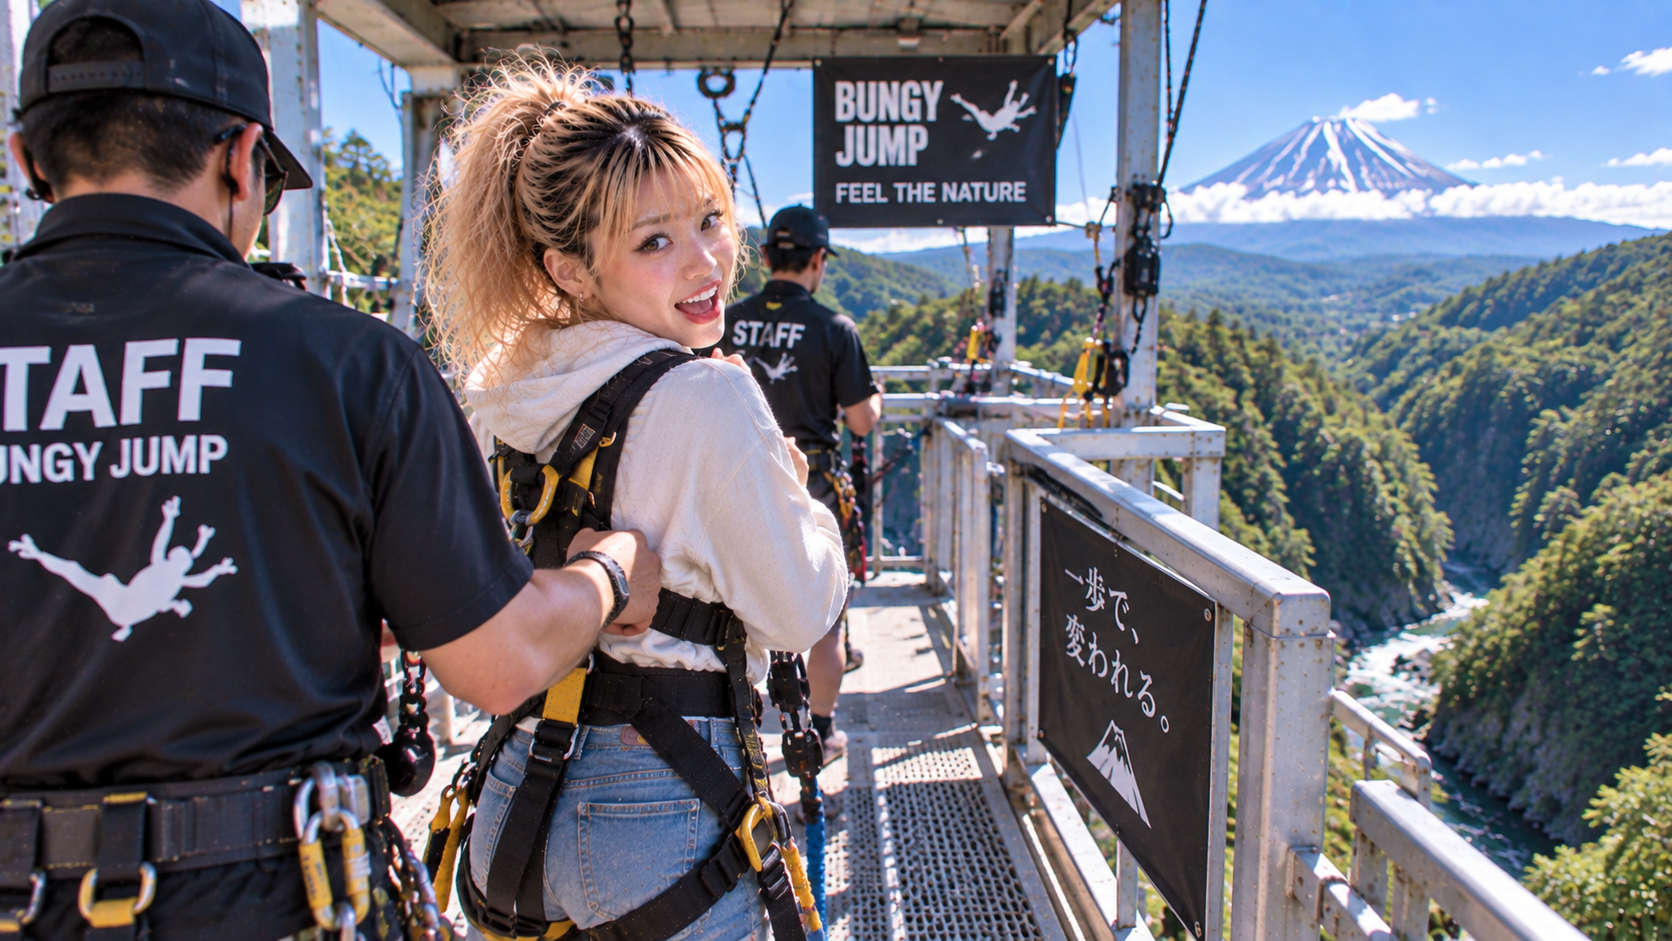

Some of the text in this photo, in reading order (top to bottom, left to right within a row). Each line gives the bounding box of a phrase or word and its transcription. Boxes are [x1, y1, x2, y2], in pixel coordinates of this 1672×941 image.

[835, 80, 944, 122] BUNGY
[835, 124, 929, 167] JUMP
[836, 181, 1027, 203] FEEL THE NATURE
[732, 320, 806, 349] STAFF
[0, 337, 242, 432] TAFF
[109, 434, 228, 479] JUMP
[1065, 567, 1140, 645] 一歩で、
[1066, 614, 1170, 733] 変われる。
